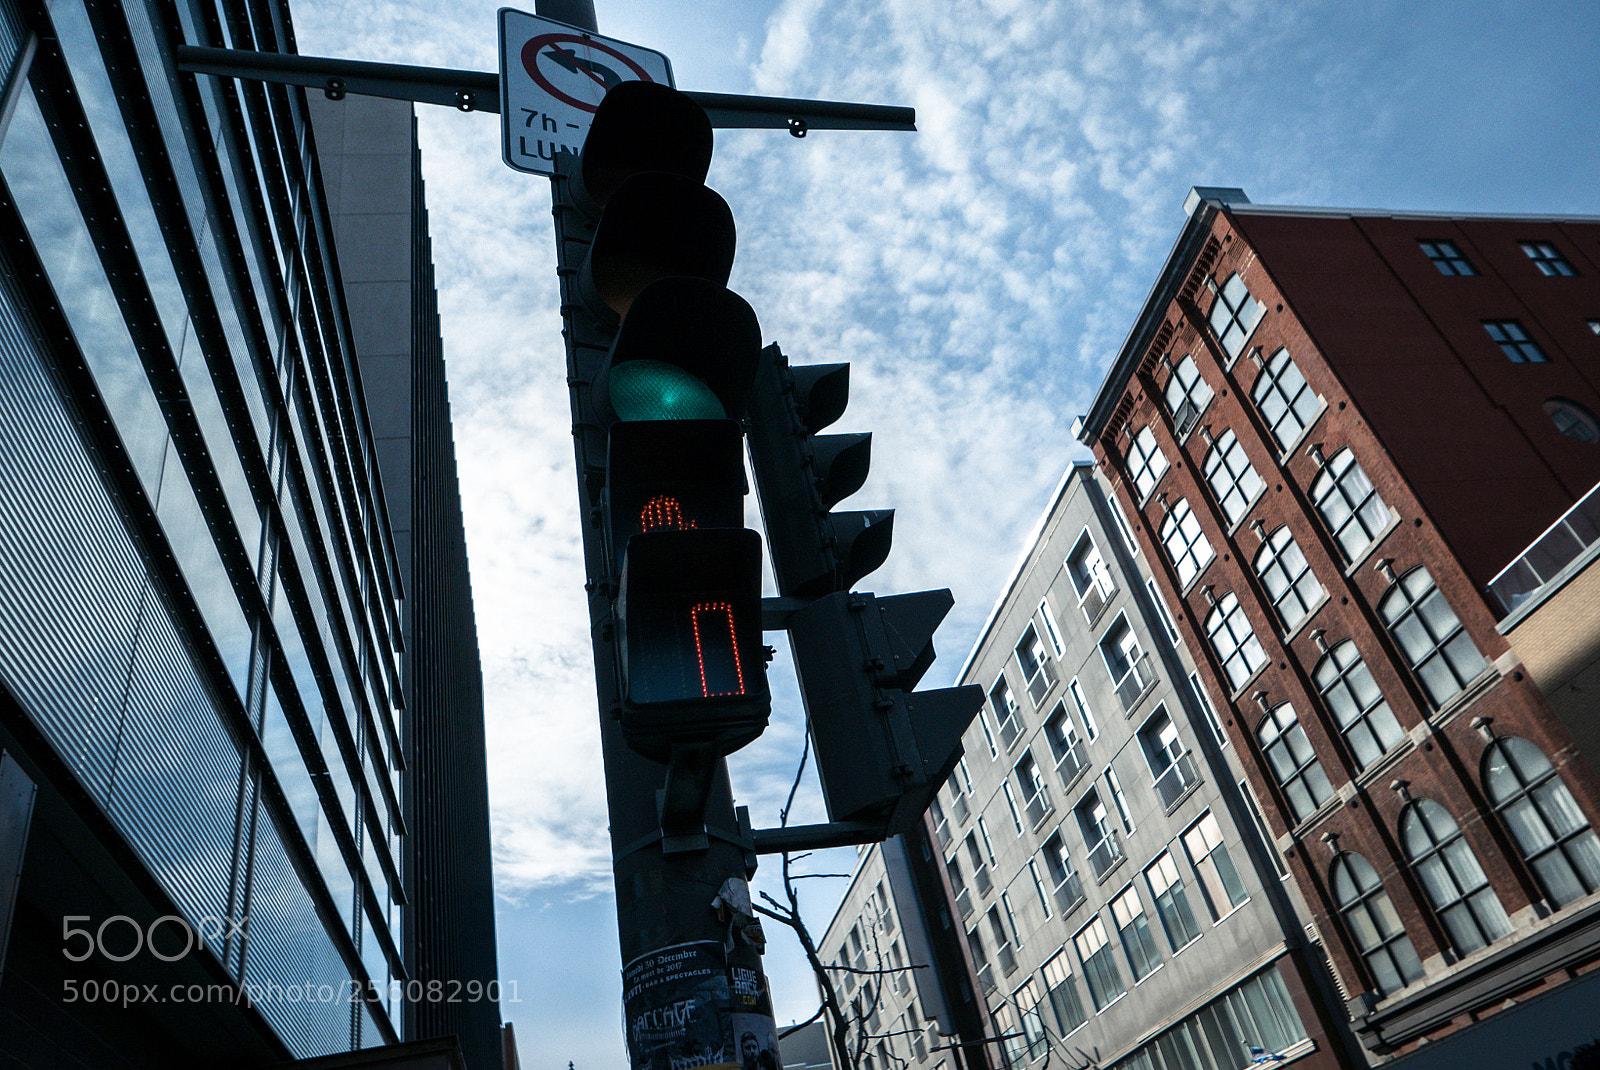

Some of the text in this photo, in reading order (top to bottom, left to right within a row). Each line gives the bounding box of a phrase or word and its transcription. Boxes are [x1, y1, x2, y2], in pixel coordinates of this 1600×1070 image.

[521, 108, 557, 133] 7h
[665, 962, 682, 972] 2017
[665, 968, 711, 982] SPECTACLES
[731, 967, 758, 984] LIGUE
